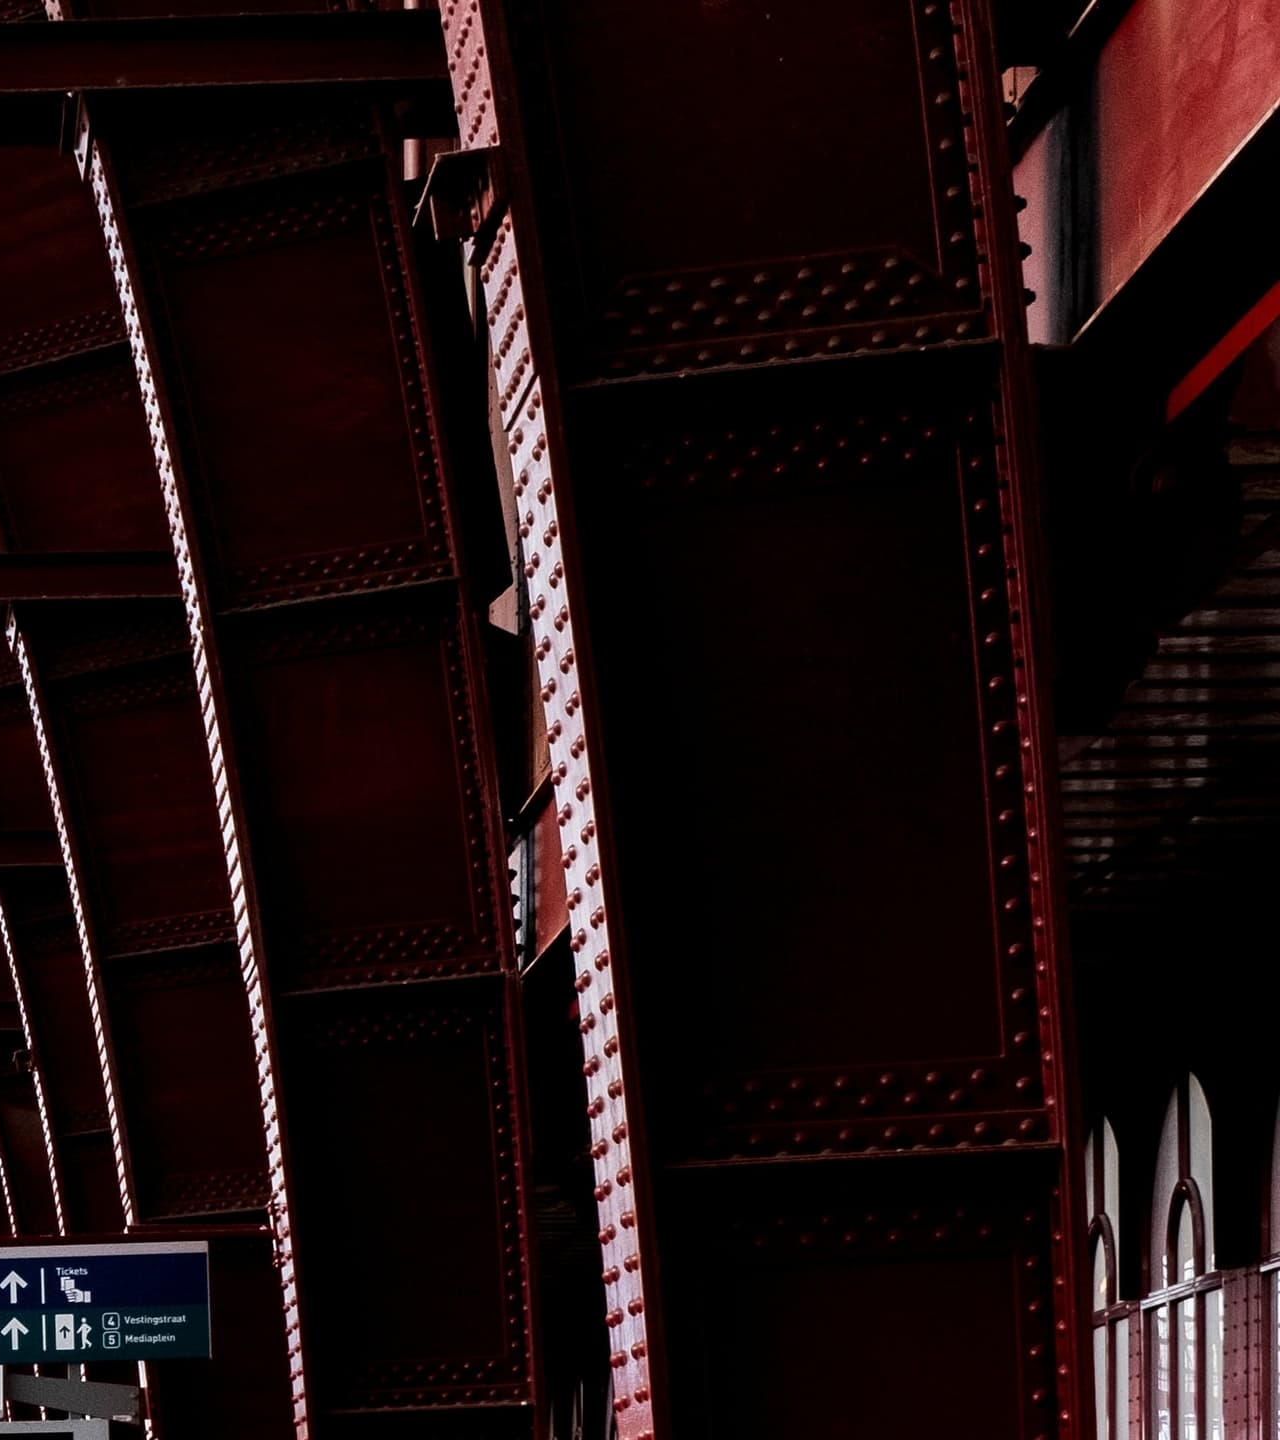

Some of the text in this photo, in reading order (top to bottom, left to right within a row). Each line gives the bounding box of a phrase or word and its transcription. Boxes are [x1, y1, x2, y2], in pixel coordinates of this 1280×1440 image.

[55, 1267, 89, 1276] Tickets
[123, 1314, 187, 1326] Vestingstraat
[125, 1333, 176, 1344] Mediaplein
